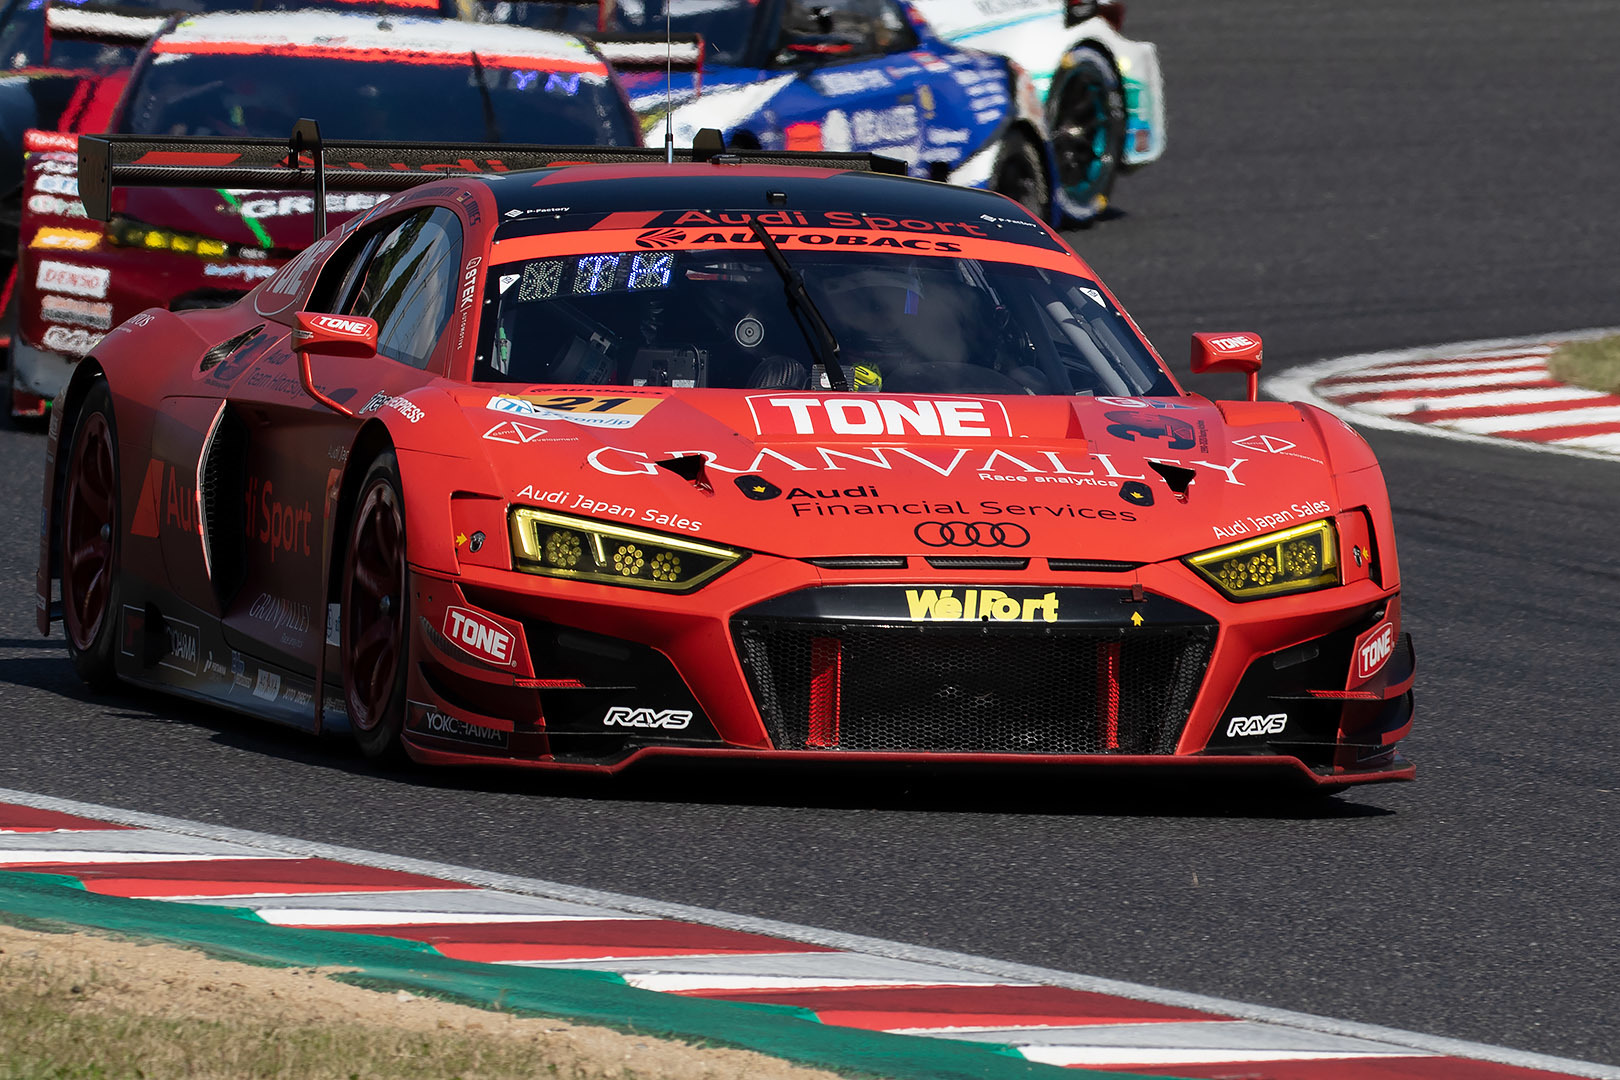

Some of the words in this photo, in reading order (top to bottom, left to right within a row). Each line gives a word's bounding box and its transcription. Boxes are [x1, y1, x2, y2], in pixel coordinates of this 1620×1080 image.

[673, 210, 809, 225] Audi
[823, 211, 988, 237] Sport
[691, 232, 962, 252] AUTOBACS
[318, 315, 368, 334] TONE
[1212, 336, 1254, 350] TONE
[533, 397, 632, 412] 21
[769, 398, 992, 437] TONE
[786, 486, 879, 499] Audi
[978, 473, 1028, 482] Race
[1034, 474, 1119, 488] analytics
[517, 485, 569, 505] Audi
[570, 494, 636, 518] Japan
[641, 508, 703, 532] Sales
[791, 501, 971, 517] Financial
[980, 501, 1137, 522] Services
[1213, 519, 1251, 540] Audi
[1246, 510, 1295, 532] Japan
[1290, 500, 1331, 518] Sales
[260, 479, 312, 563] Sport
[451, 610, 509, 660] TONE
[1361, 627, 1392, 673] TONE
[603, 706, 693, 729] RAYS
[1226, 713, 1288, 738] RAYS
